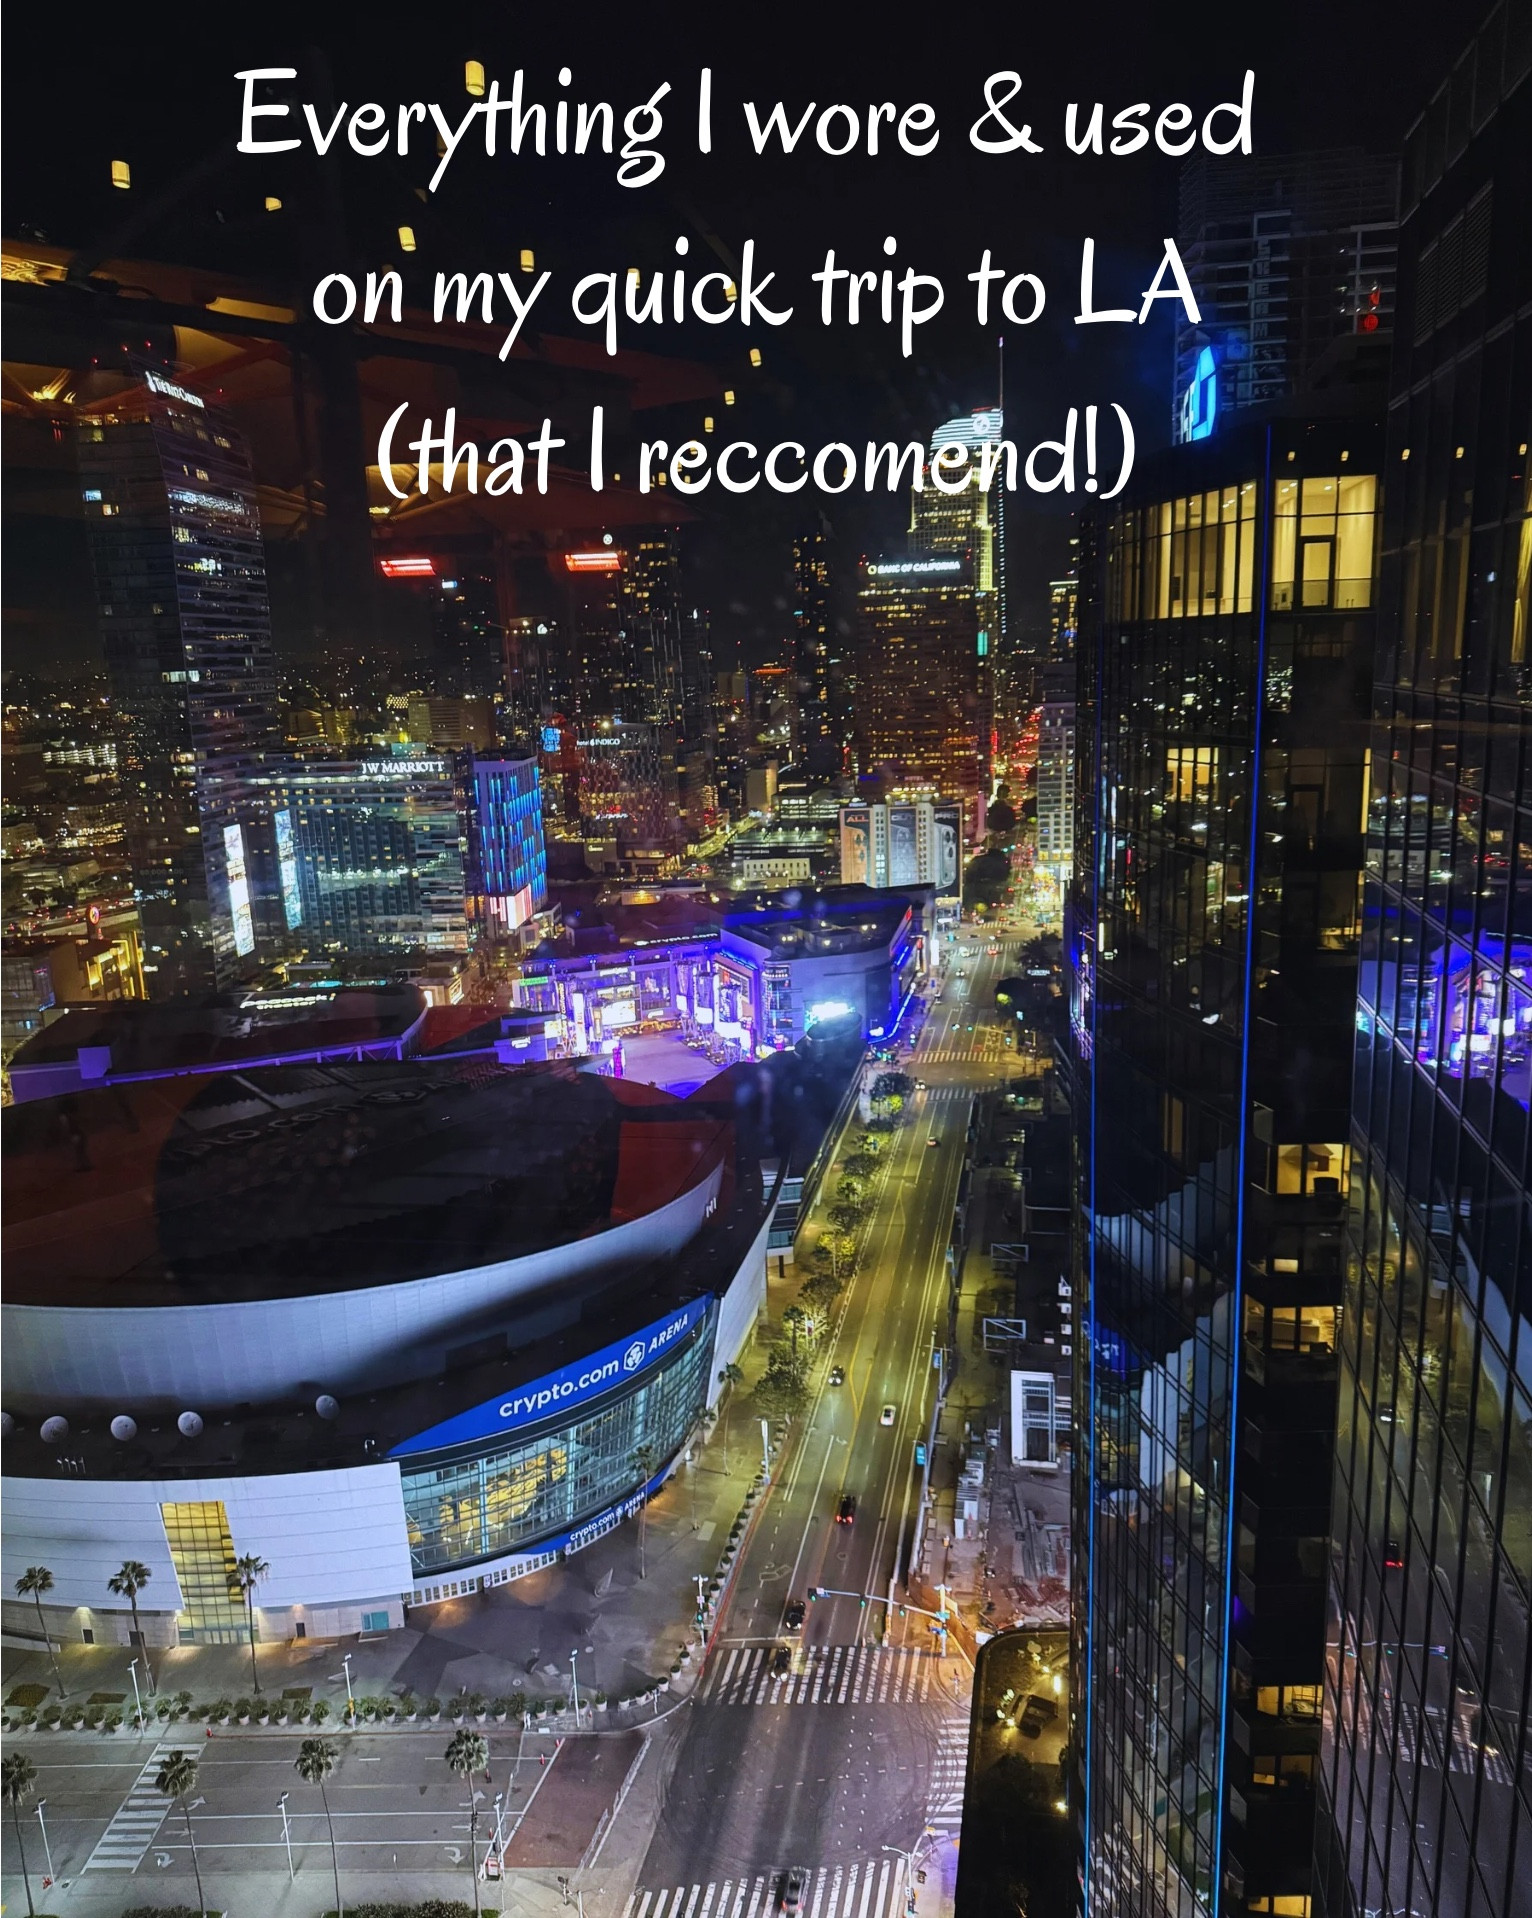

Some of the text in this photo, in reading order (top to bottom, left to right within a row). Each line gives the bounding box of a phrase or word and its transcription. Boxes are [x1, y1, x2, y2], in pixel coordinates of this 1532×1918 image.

[381, 761, 444, 774] MARRIOTT
[499, 1313, 689, 1417] crypto.com ARENA
[570, 1512, 615, 1541] crypto.com
